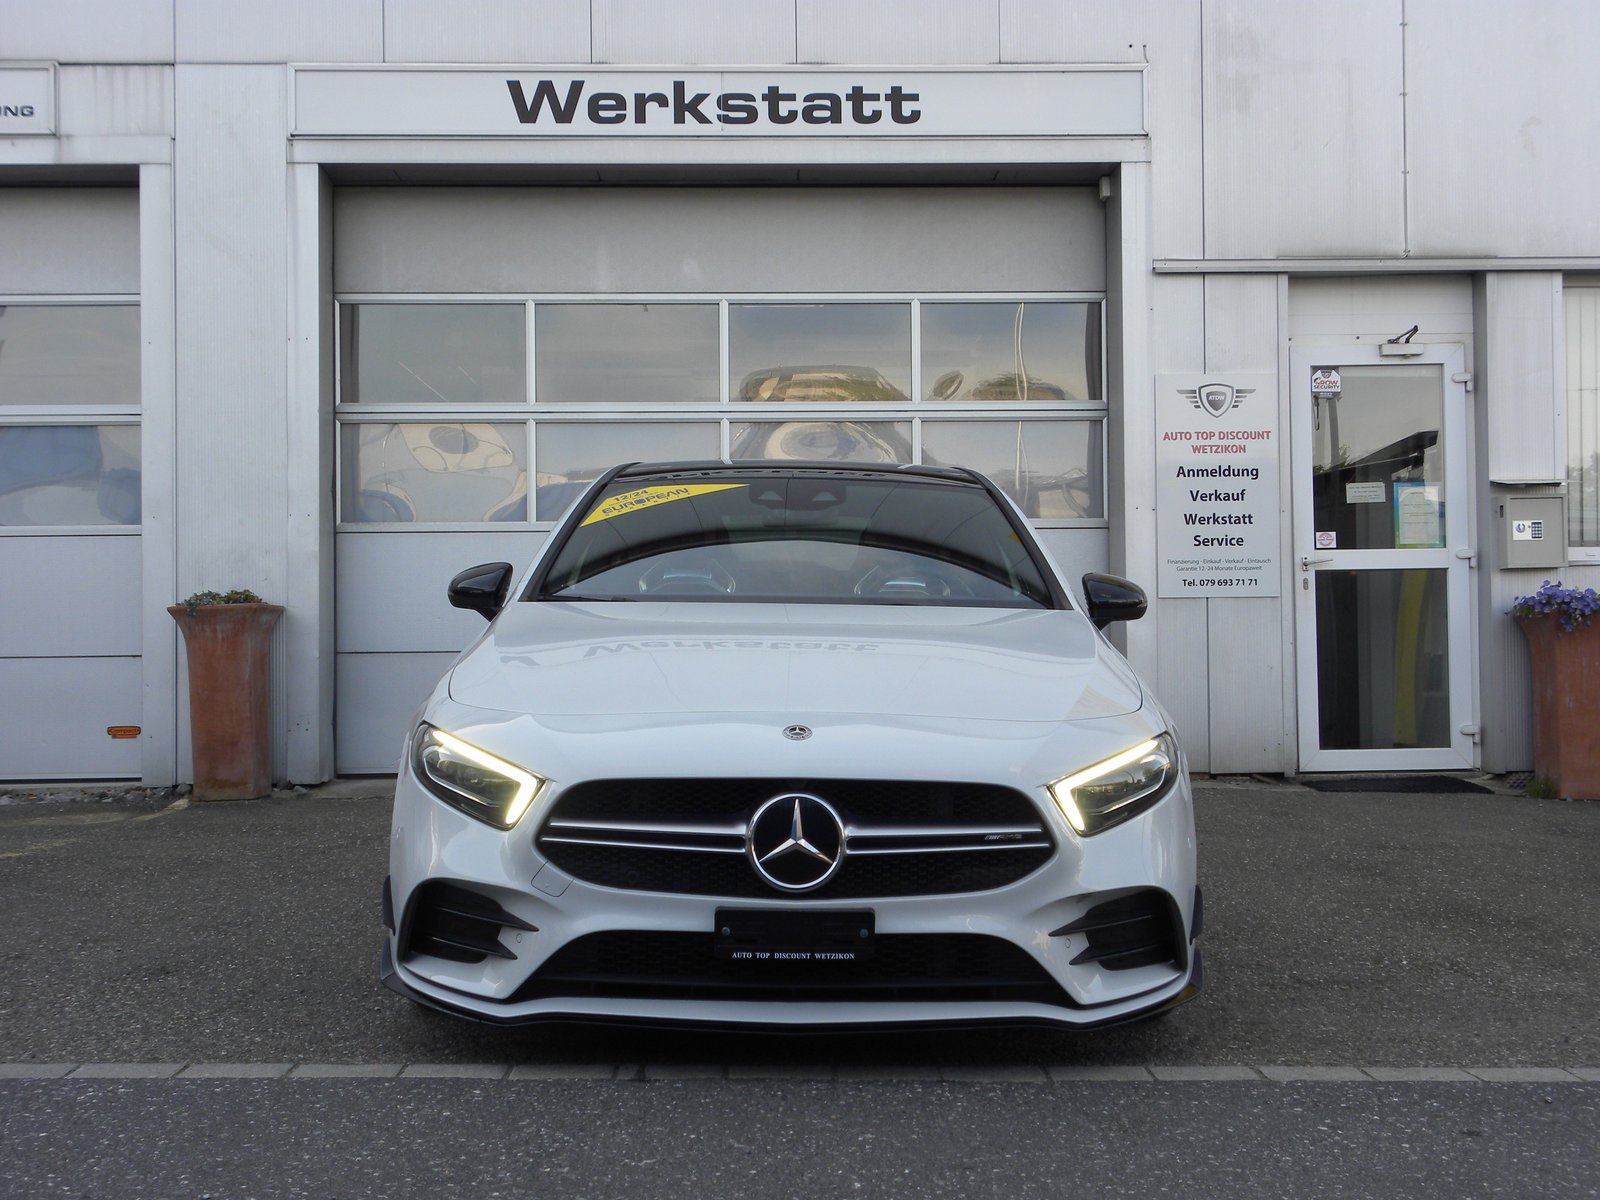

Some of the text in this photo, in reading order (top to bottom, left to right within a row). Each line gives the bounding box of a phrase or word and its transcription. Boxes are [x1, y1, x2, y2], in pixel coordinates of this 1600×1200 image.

[506, 79, 922, 125] Werkstatt
[1163, 430, 1272, 441] AUTO TOP DISCOUNT
[1191, 444, 1246, 454] WETZIKON
[1176, 465, 1259, 480] Anmeldung
[601, 487, 689, 515] EUROPEAN
[614, 489, 649, 502] 12/24
[1189, 489, 1246, 502] Verkauf
[1183, 512, 1253, 525] Werkstatt
[1193, 535, 1244, 547] Service
[1182, 578, 1258, 587] Tel. 079 693 71 71
[731, 951, 856, 960] AUTO TOP DISCOUNT WETZIKON
